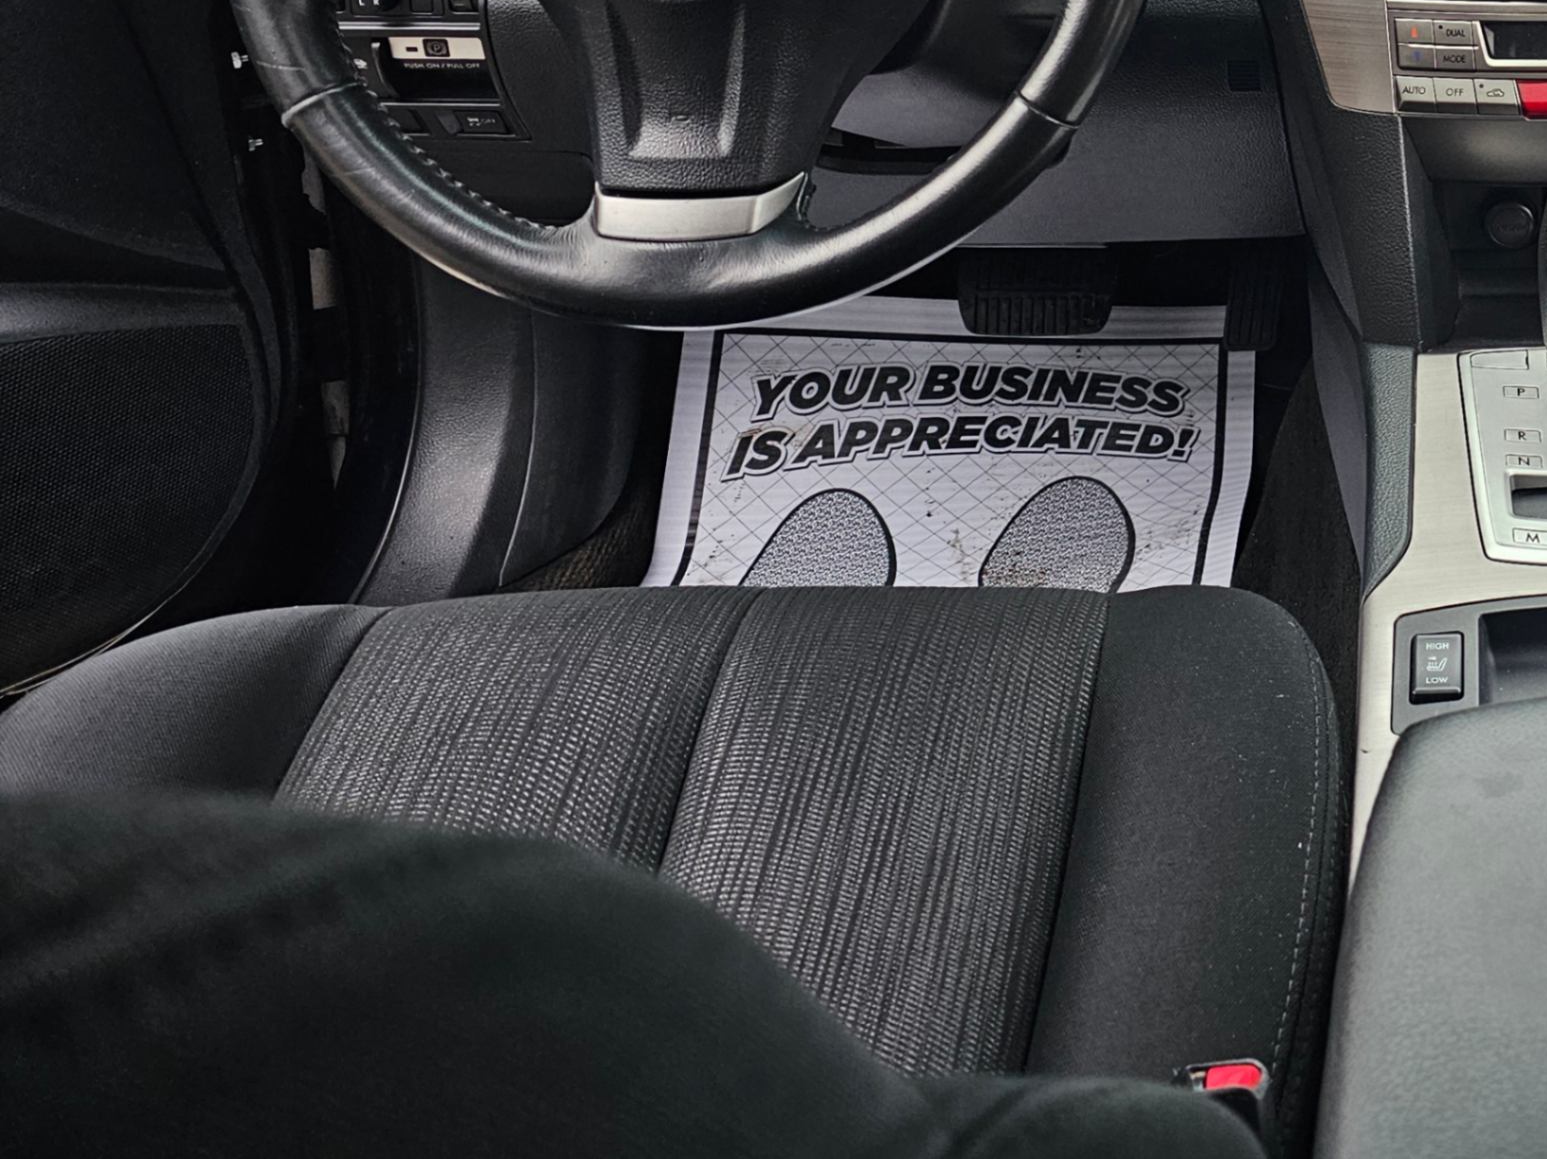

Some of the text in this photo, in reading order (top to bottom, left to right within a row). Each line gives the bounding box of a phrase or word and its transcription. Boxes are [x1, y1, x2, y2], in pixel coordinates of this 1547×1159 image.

[1446, 28, 1467, 38] DUAL
[1442, 55, 1466, 64] MODE
[1402, 86, 1426, 95] AUTO
[1446, 87, 1465, 97] OFF
[753, 363, 1192, 420] YOUR BUSINESS
[1516, 387, 1526, 397] P
[1518, 430, 1527, 441] R
[725, 414, 1198, 476] IS APPRECIATED!
[1517, 456, 1531, 466] N
[1525, 532, 1540, 544] M
[1425, 641, 1450, 651] HIGH
[1425, 676, 1449, 685] LOW
